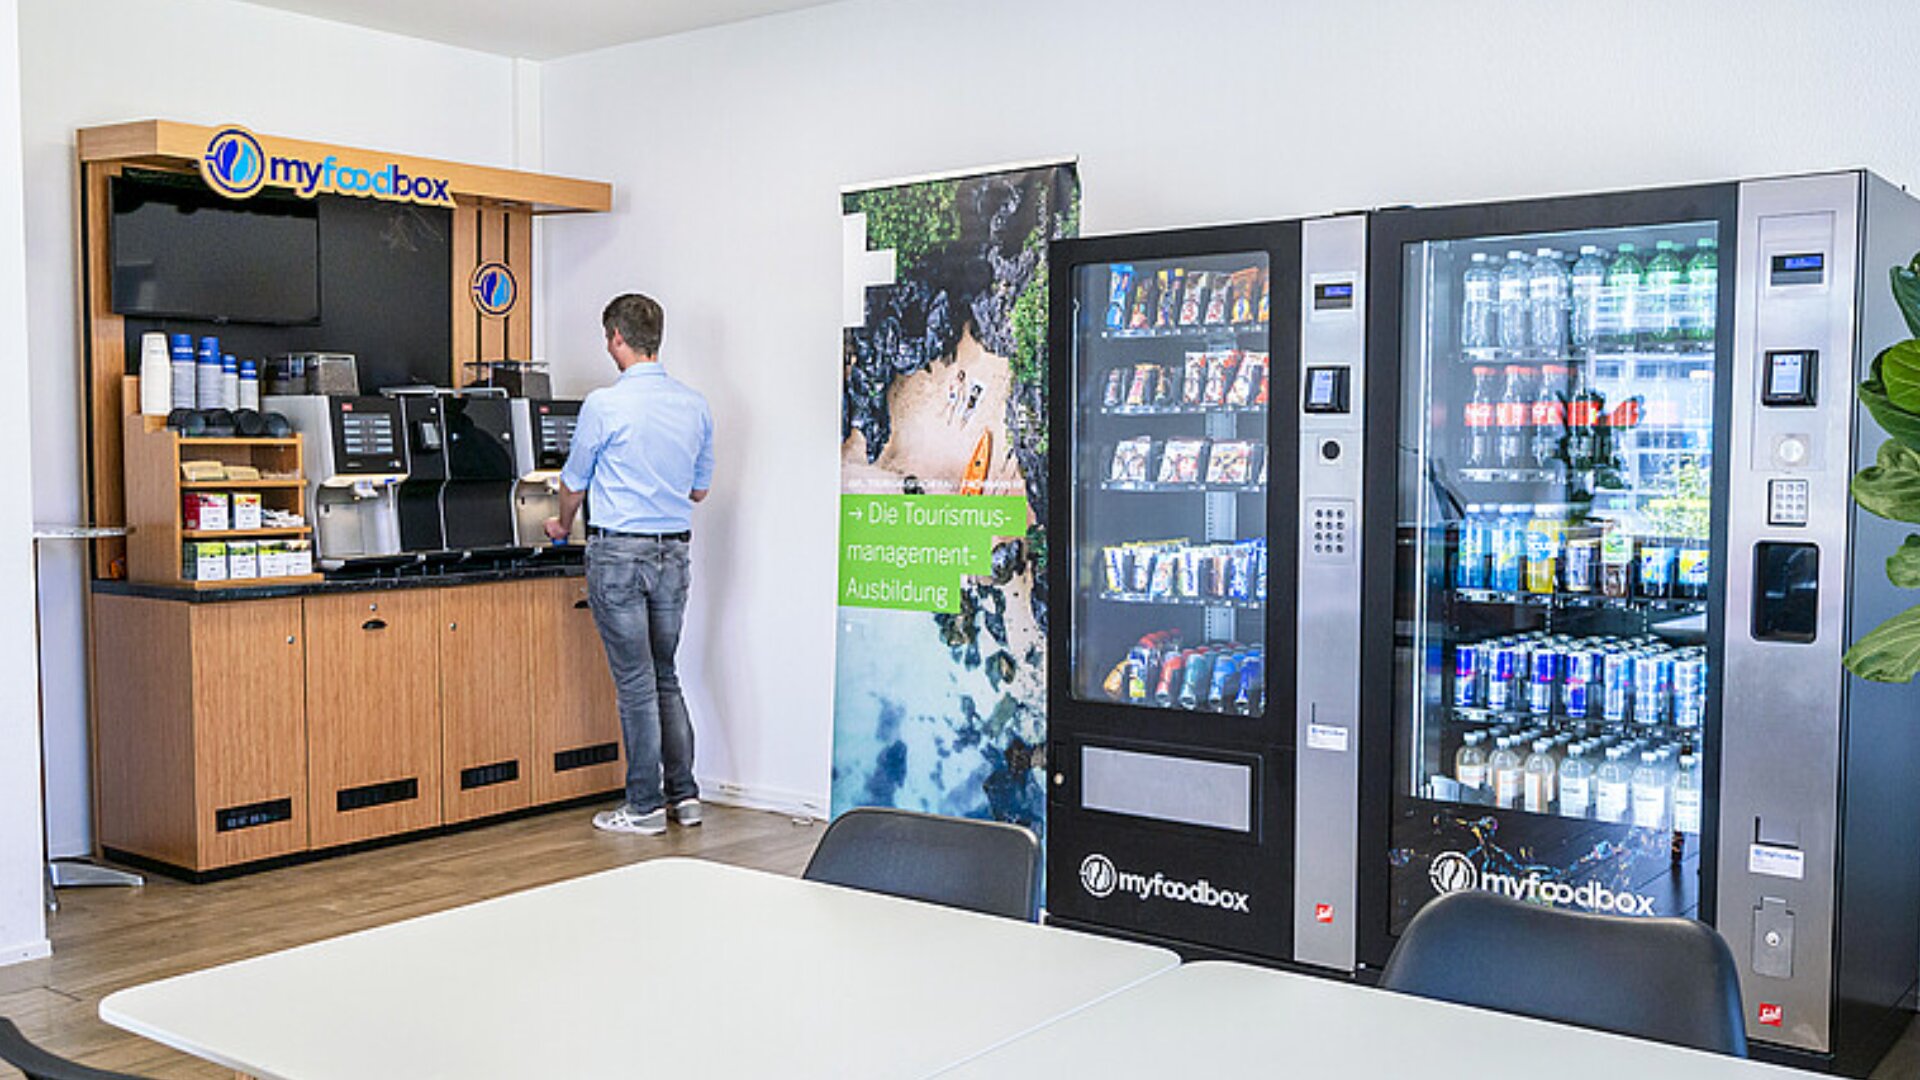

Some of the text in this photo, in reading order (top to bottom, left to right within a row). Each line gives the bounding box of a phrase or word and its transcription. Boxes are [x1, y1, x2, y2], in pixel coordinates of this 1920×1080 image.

[270, 155, 449, 201] myfoodbox
[868, 501, 1012, 527] Die Tourismus-
[847, 544, 977, 568] management-
[846, 577, 948, 609] Ausbildung
[1119, 872, 1250, 913] myfoodbox
[1481, 872, 1656, 916] myfoodbox
